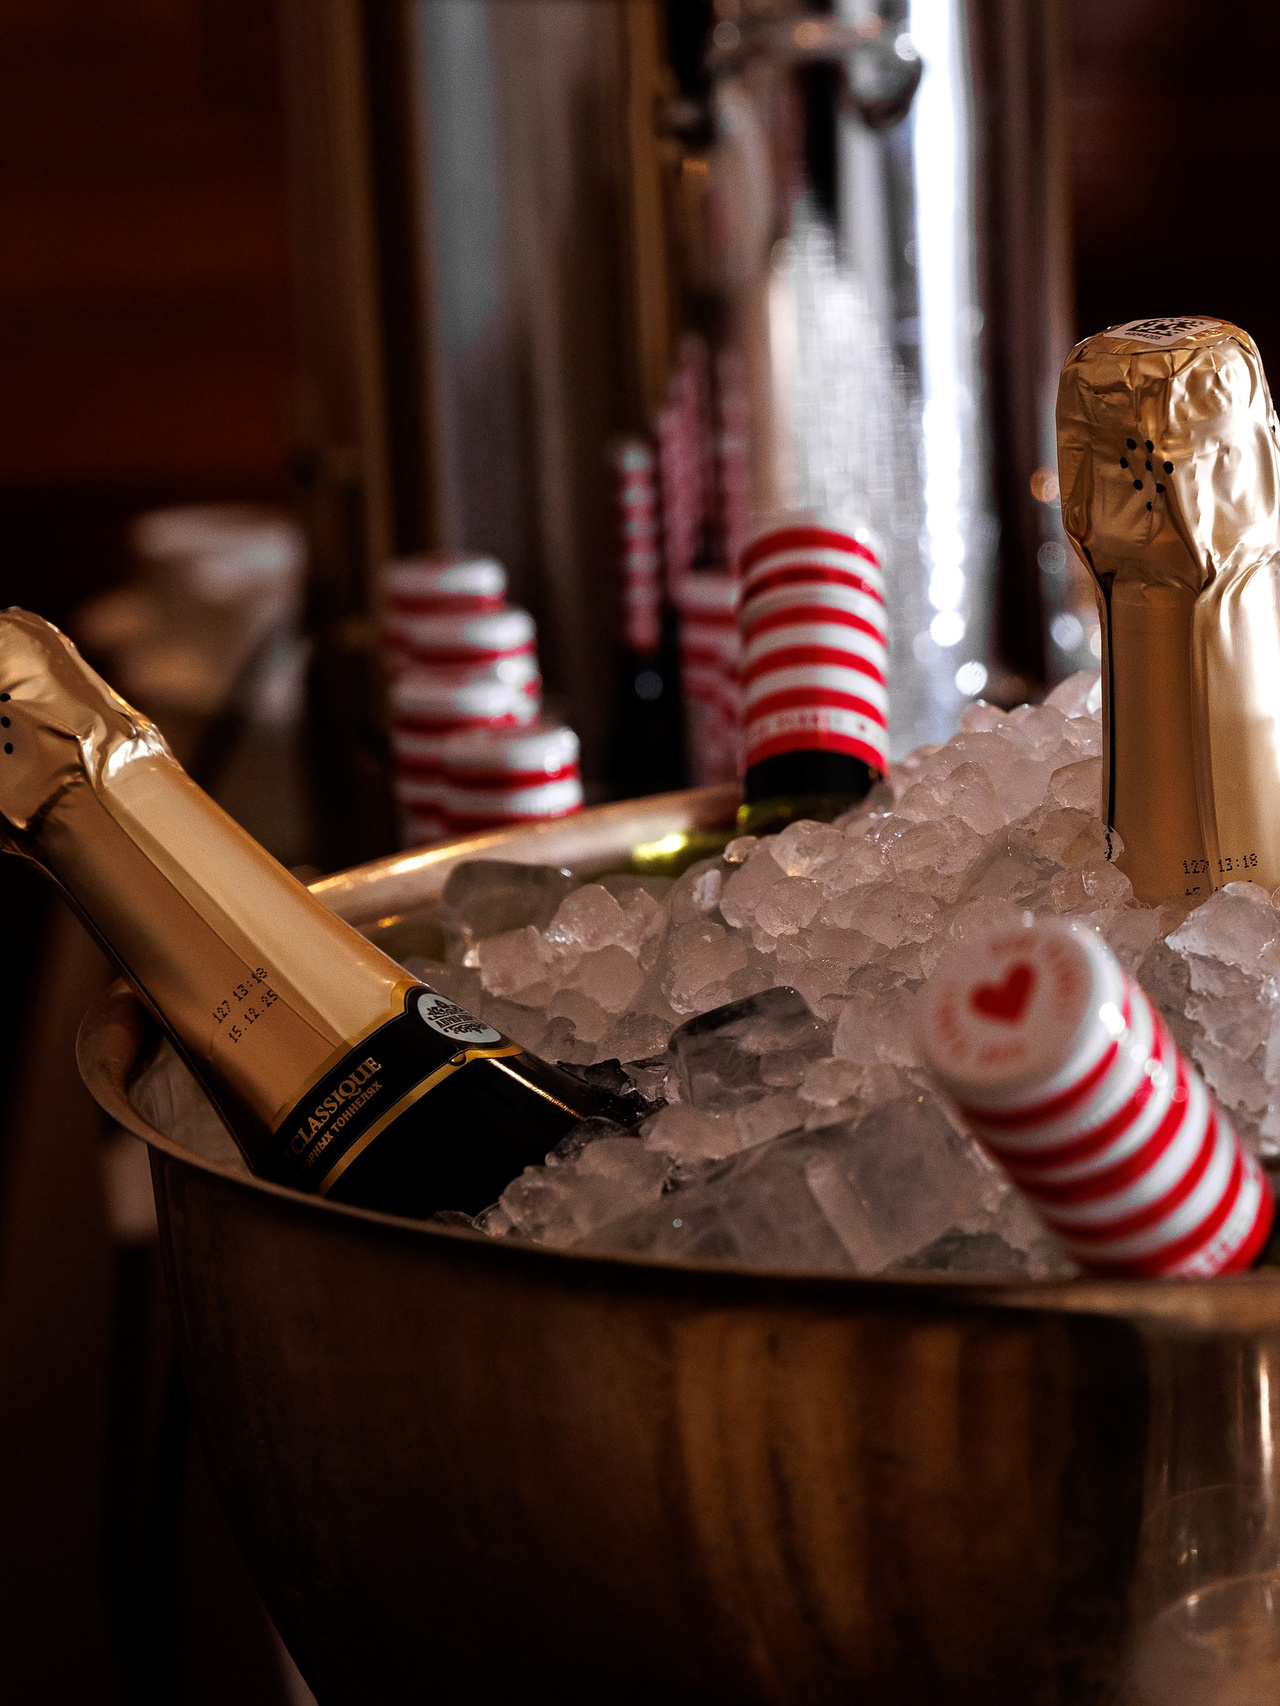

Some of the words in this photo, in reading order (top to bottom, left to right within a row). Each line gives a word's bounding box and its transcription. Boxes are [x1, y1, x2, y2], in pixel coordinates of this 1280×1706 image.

[1182, 859, 1210, 875] 127
[1218, 853, 1258, 872] 13:18
[212, 1000, 231, 1024] 127
[232, 967, 268, 1001] 13:18
[291, 1056, 382, 1155] CLASSIQUE
[331, 1080, 383, 1138] ТОННЕЛЯХ
